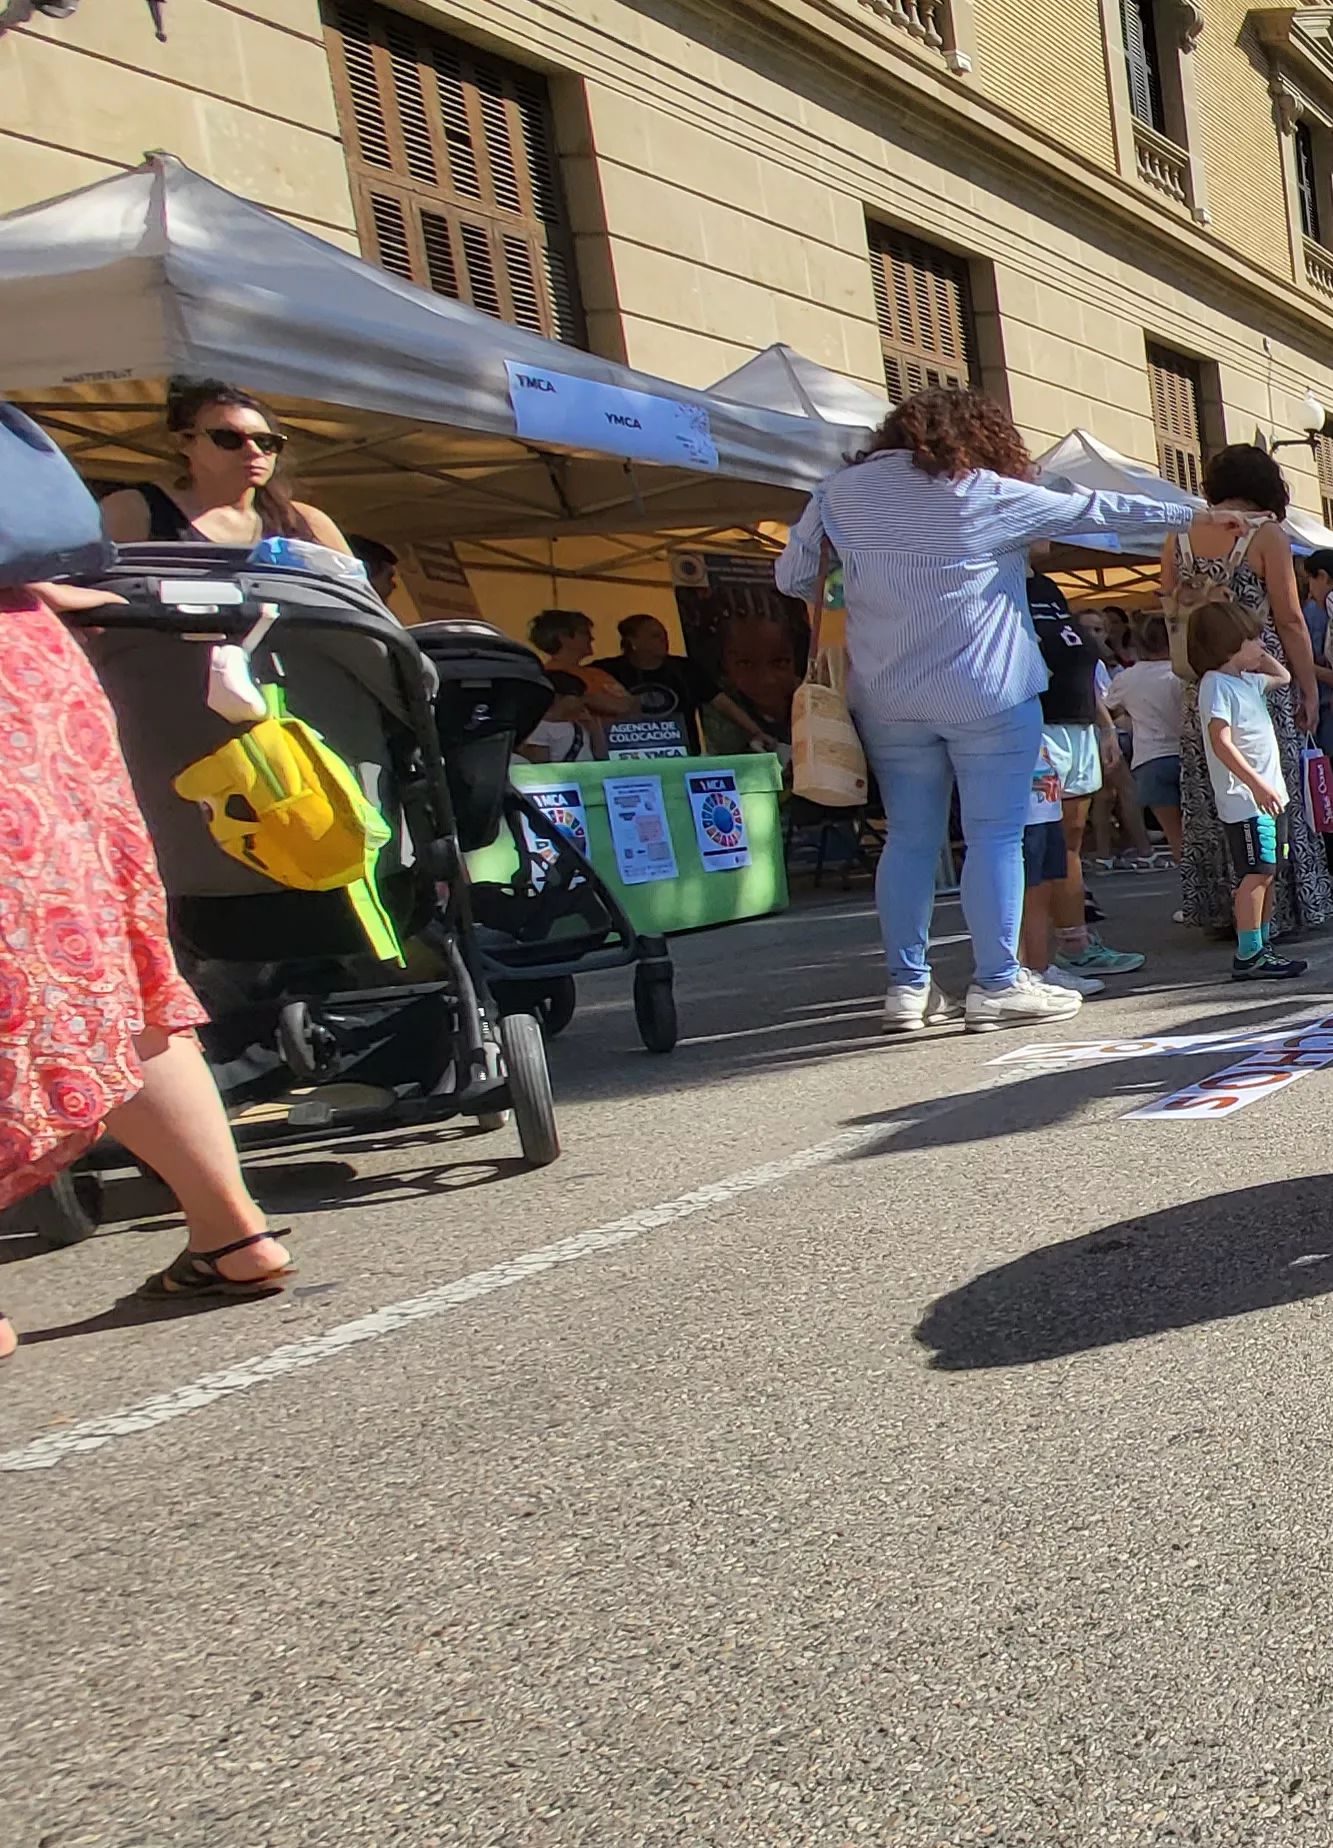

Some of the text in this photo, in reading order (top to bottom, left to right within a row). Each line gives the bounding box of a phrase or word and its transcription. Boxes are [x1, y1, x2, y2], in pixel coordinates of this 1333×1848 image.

[516, 373, 557, 393] YMCA
[604, 412, 642, 430] YMCA
[610, 721, 676, 733] AGENCIA DE
